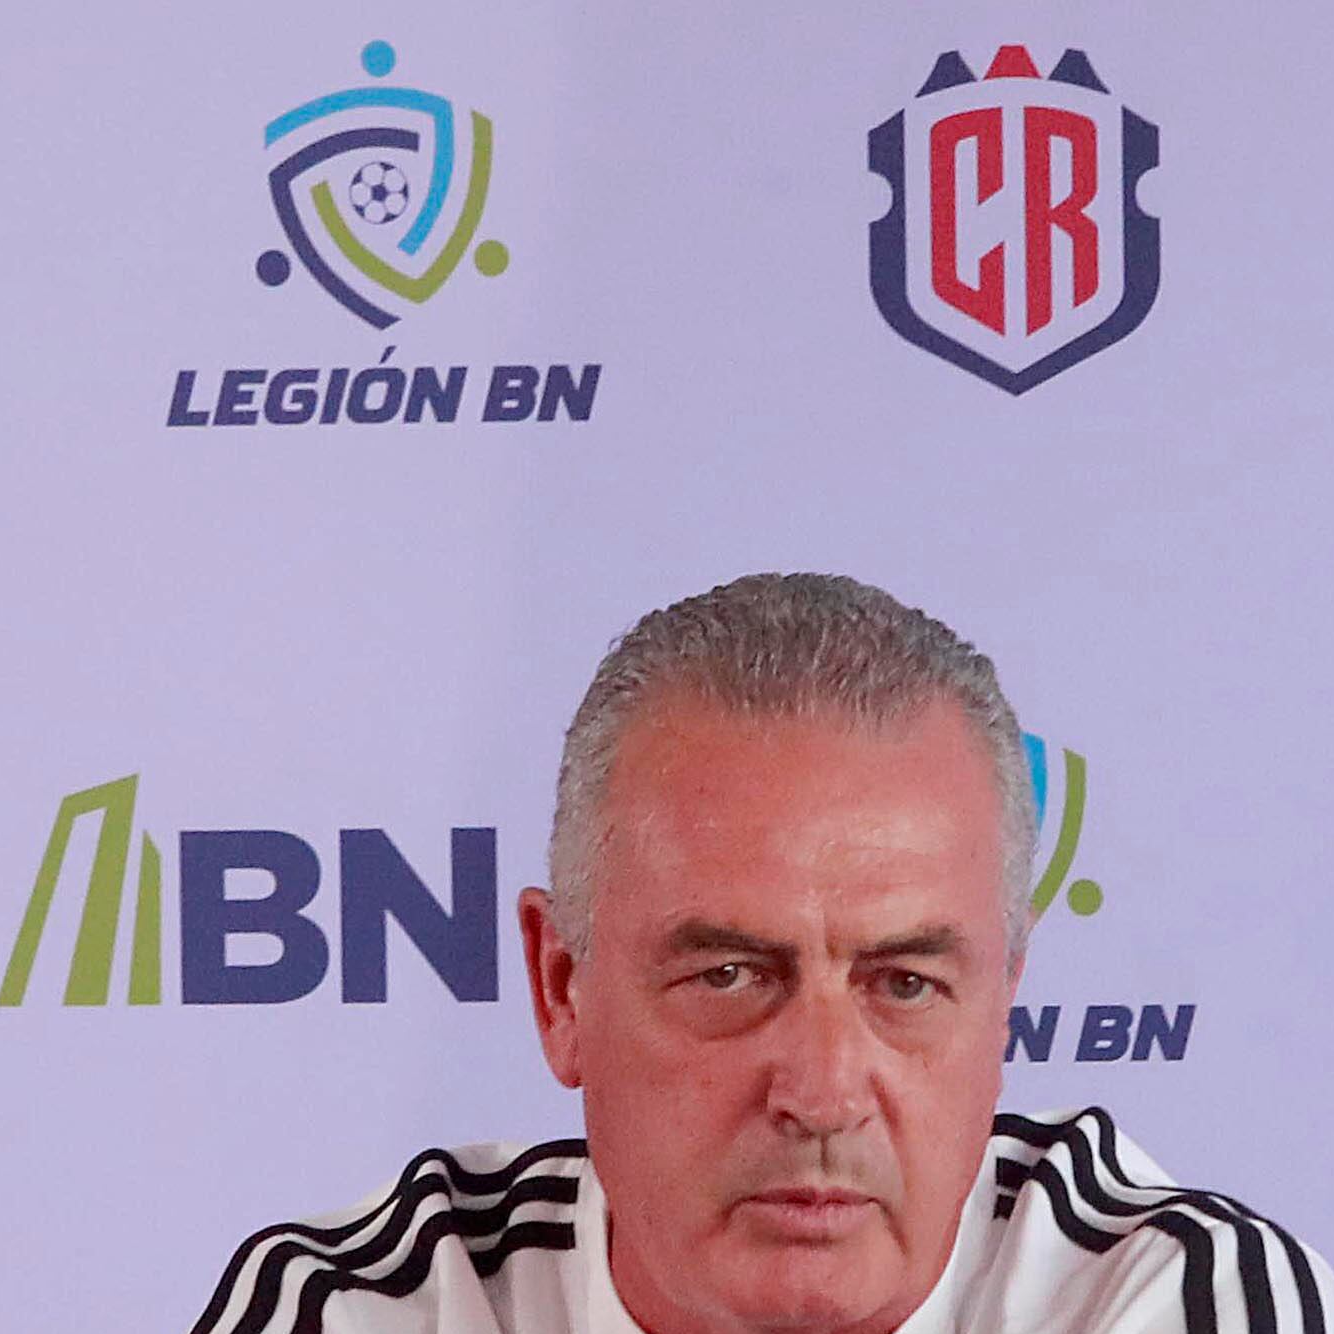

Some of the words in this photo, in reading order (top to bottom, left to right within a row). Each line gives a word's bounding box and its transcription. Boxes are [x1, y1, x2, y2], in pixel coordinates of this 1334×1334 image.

[930, 105, 1100, 336] CR
[166, 345, 468, 427] LEGIÓN
[481, 364, 602, 423] BN
[179, 827, 499, 1005] BN
[1074, 1004, 1196, 1063] BN
